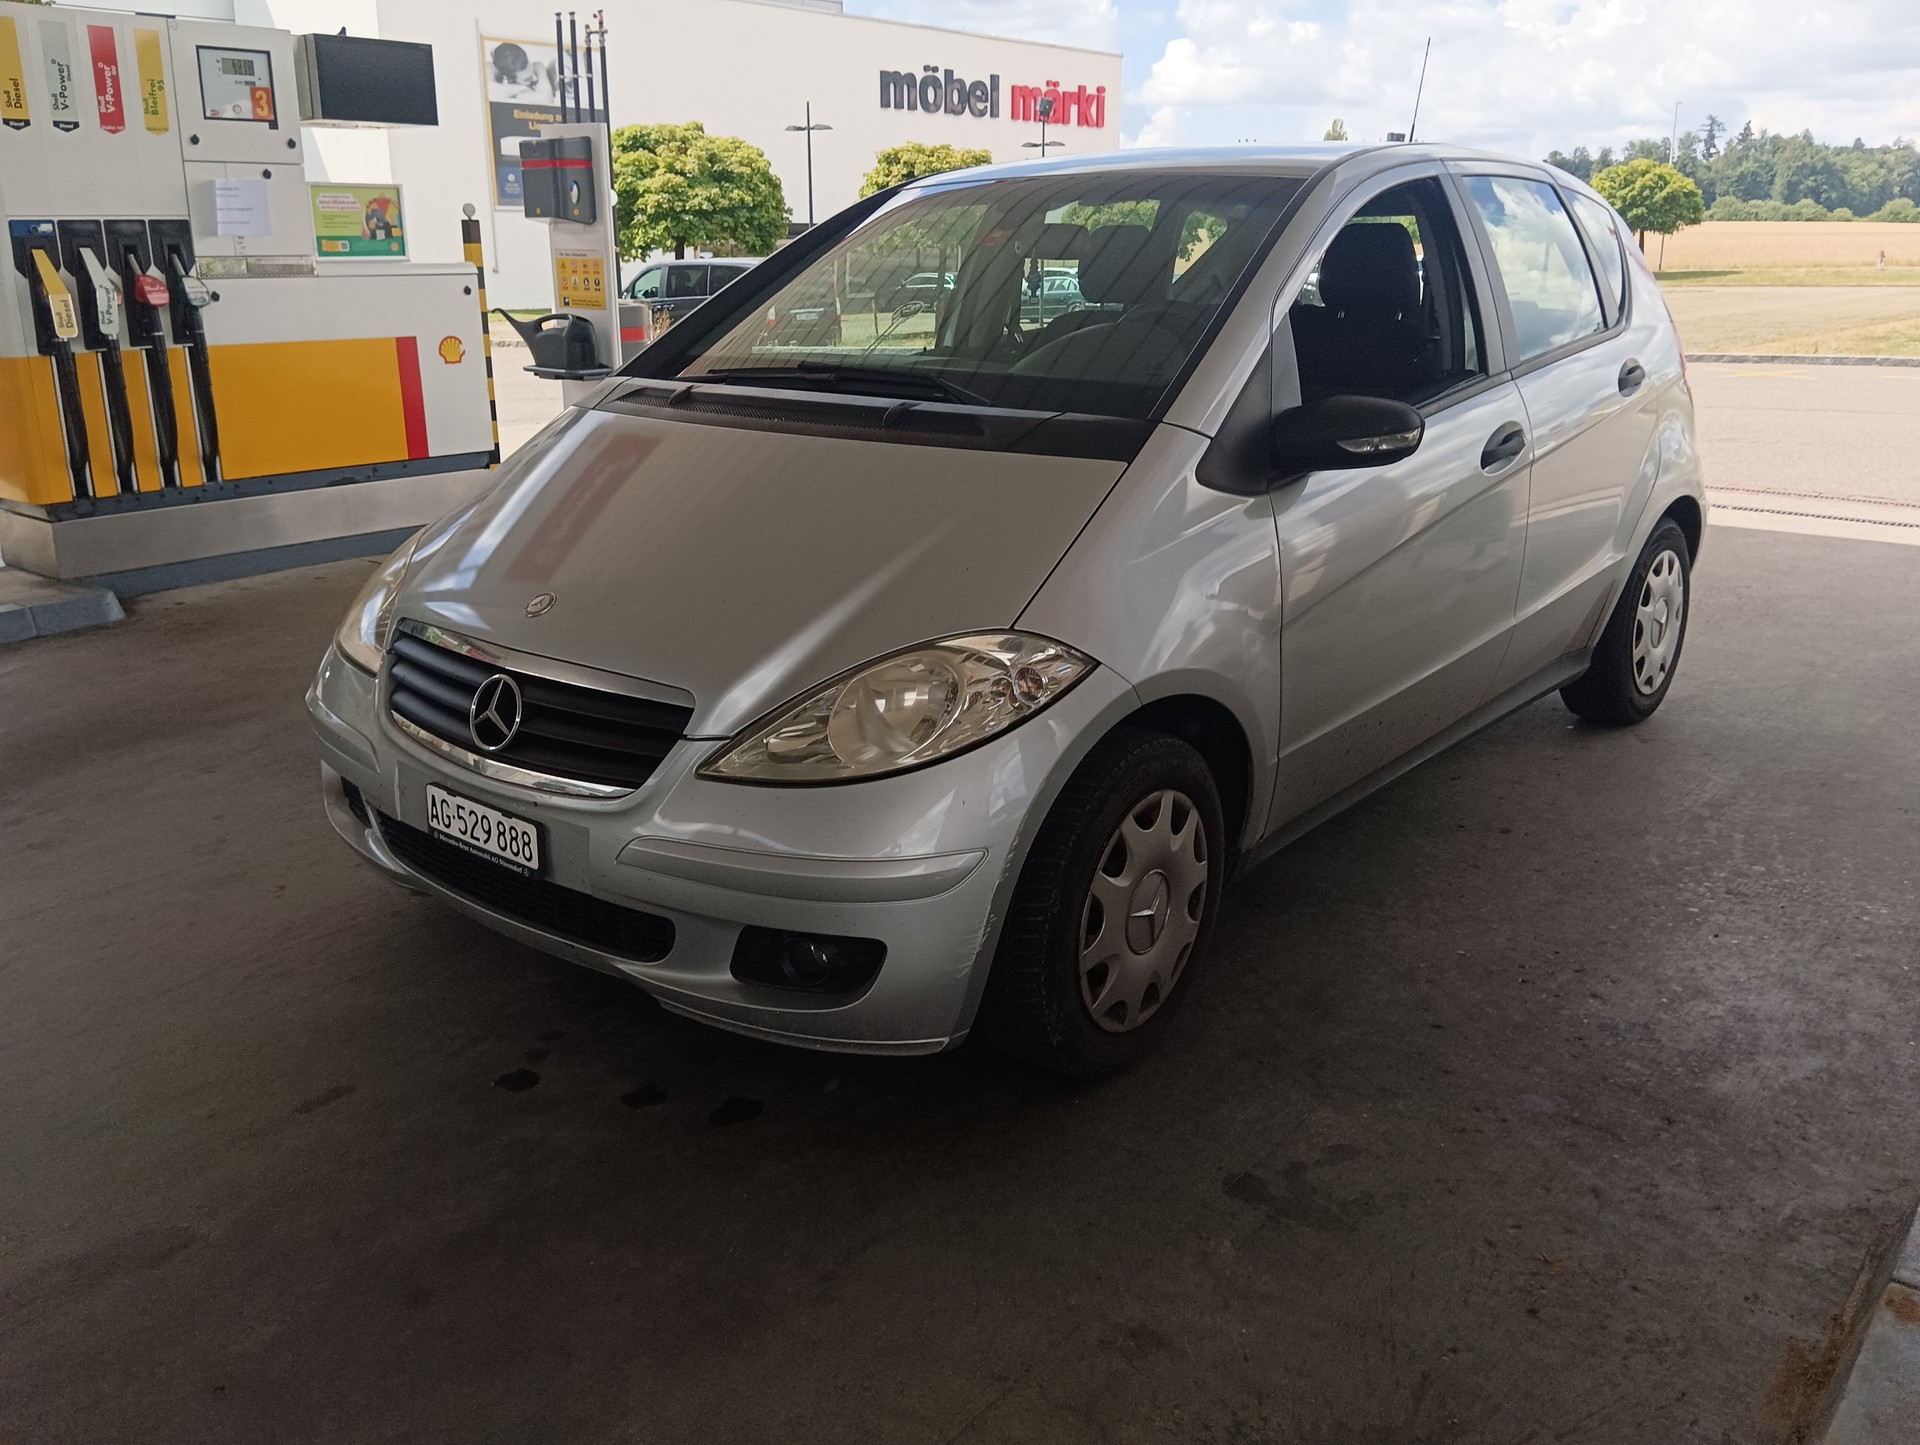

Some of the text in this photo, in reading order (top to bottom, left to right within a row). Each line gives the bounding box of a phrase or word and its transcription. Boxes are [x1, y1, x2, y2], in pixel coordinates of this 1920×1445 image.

[4, 90, 13, 108] Shell
[9, 78, 23, 109] Diesel
[58, 62, 70, 110] V-Power
[103, 65, 116, 113] V-Power
[147, 79, 159, 115] Bleifrei
[157, 80, 165, 91] 95
[880, 65, 1106, 128] möbel märki
[51, 93, 60, 111] Shell
[98, 96, 106, 113] Shell
[255, 90, 269, 117] 3
[60, 299, 74, 329] Diesel
[104, 287, 114, 325] V-Power
[496, 820, 533, 863] 888
